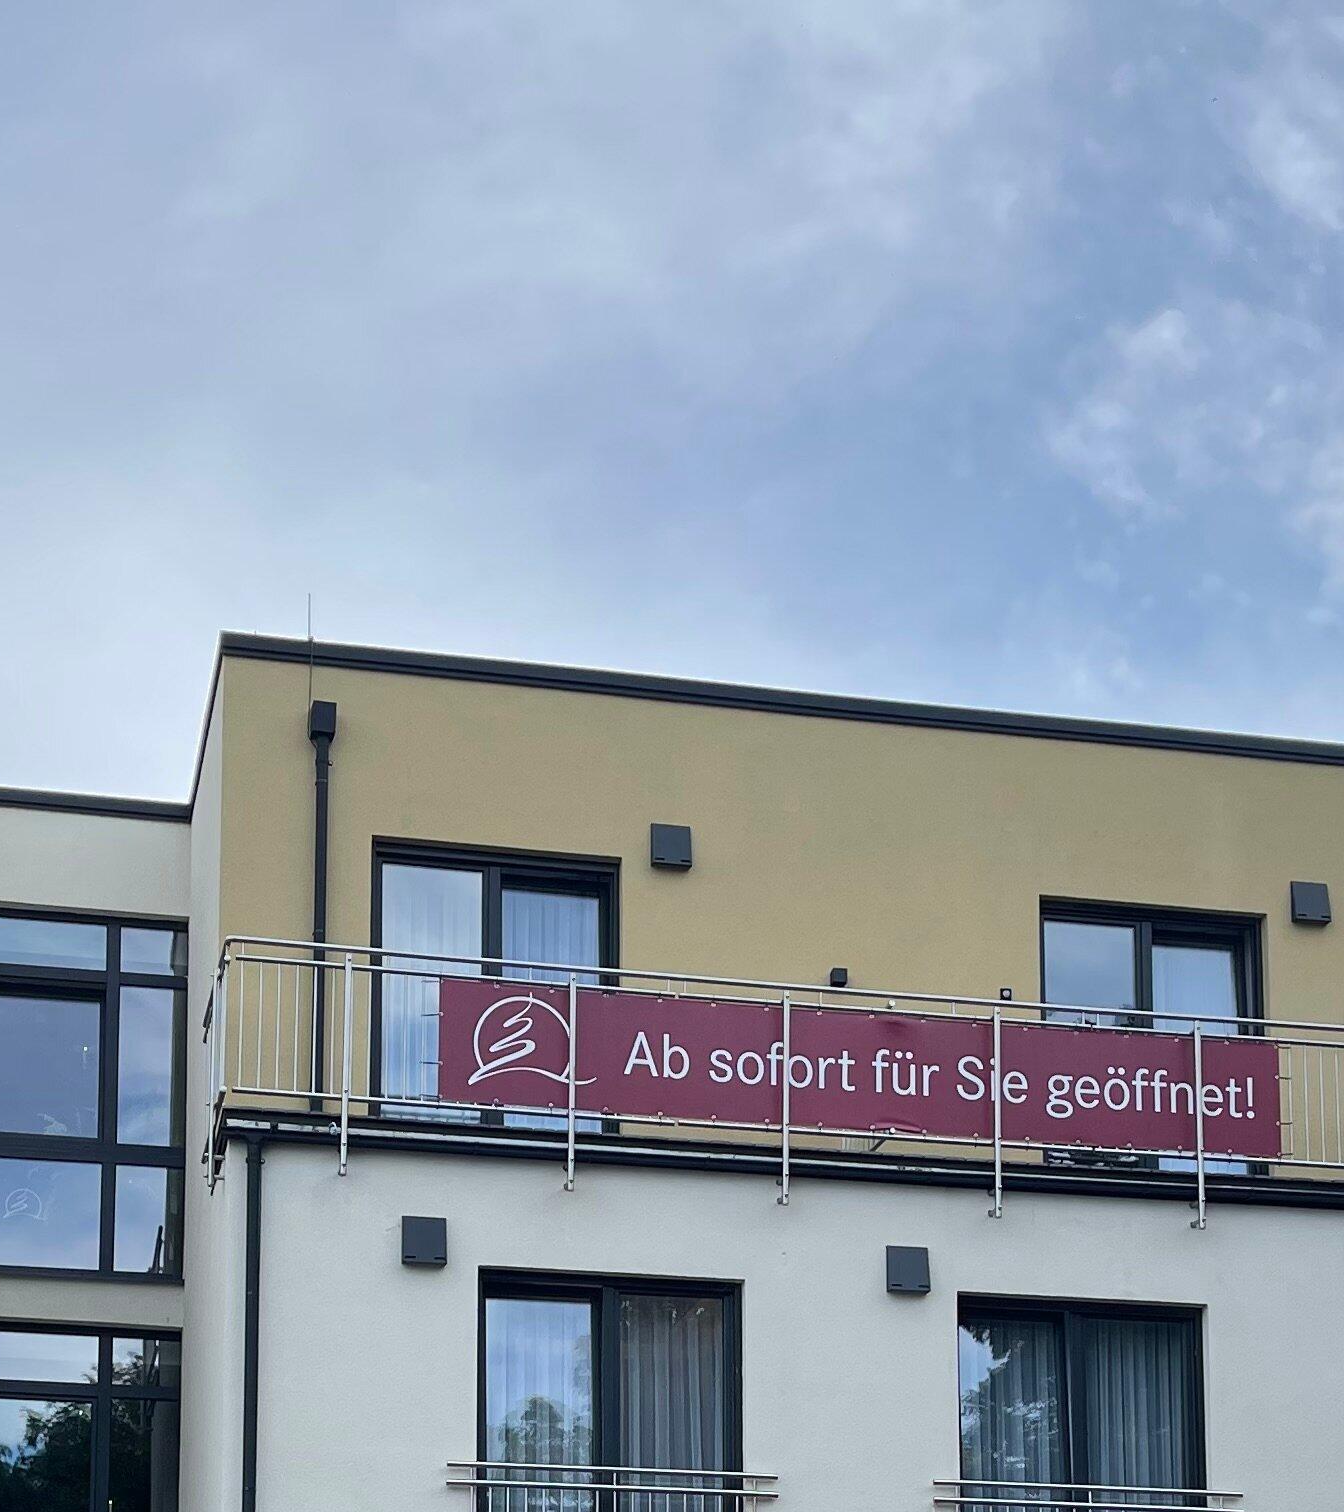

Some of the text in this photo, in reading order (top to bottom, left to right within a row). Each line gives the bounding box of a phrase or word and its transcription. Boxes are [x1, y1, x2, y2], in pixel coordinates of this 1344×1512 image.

[623, 1031, 1256, 1119] Ab sofort für Sie geöffnet!
